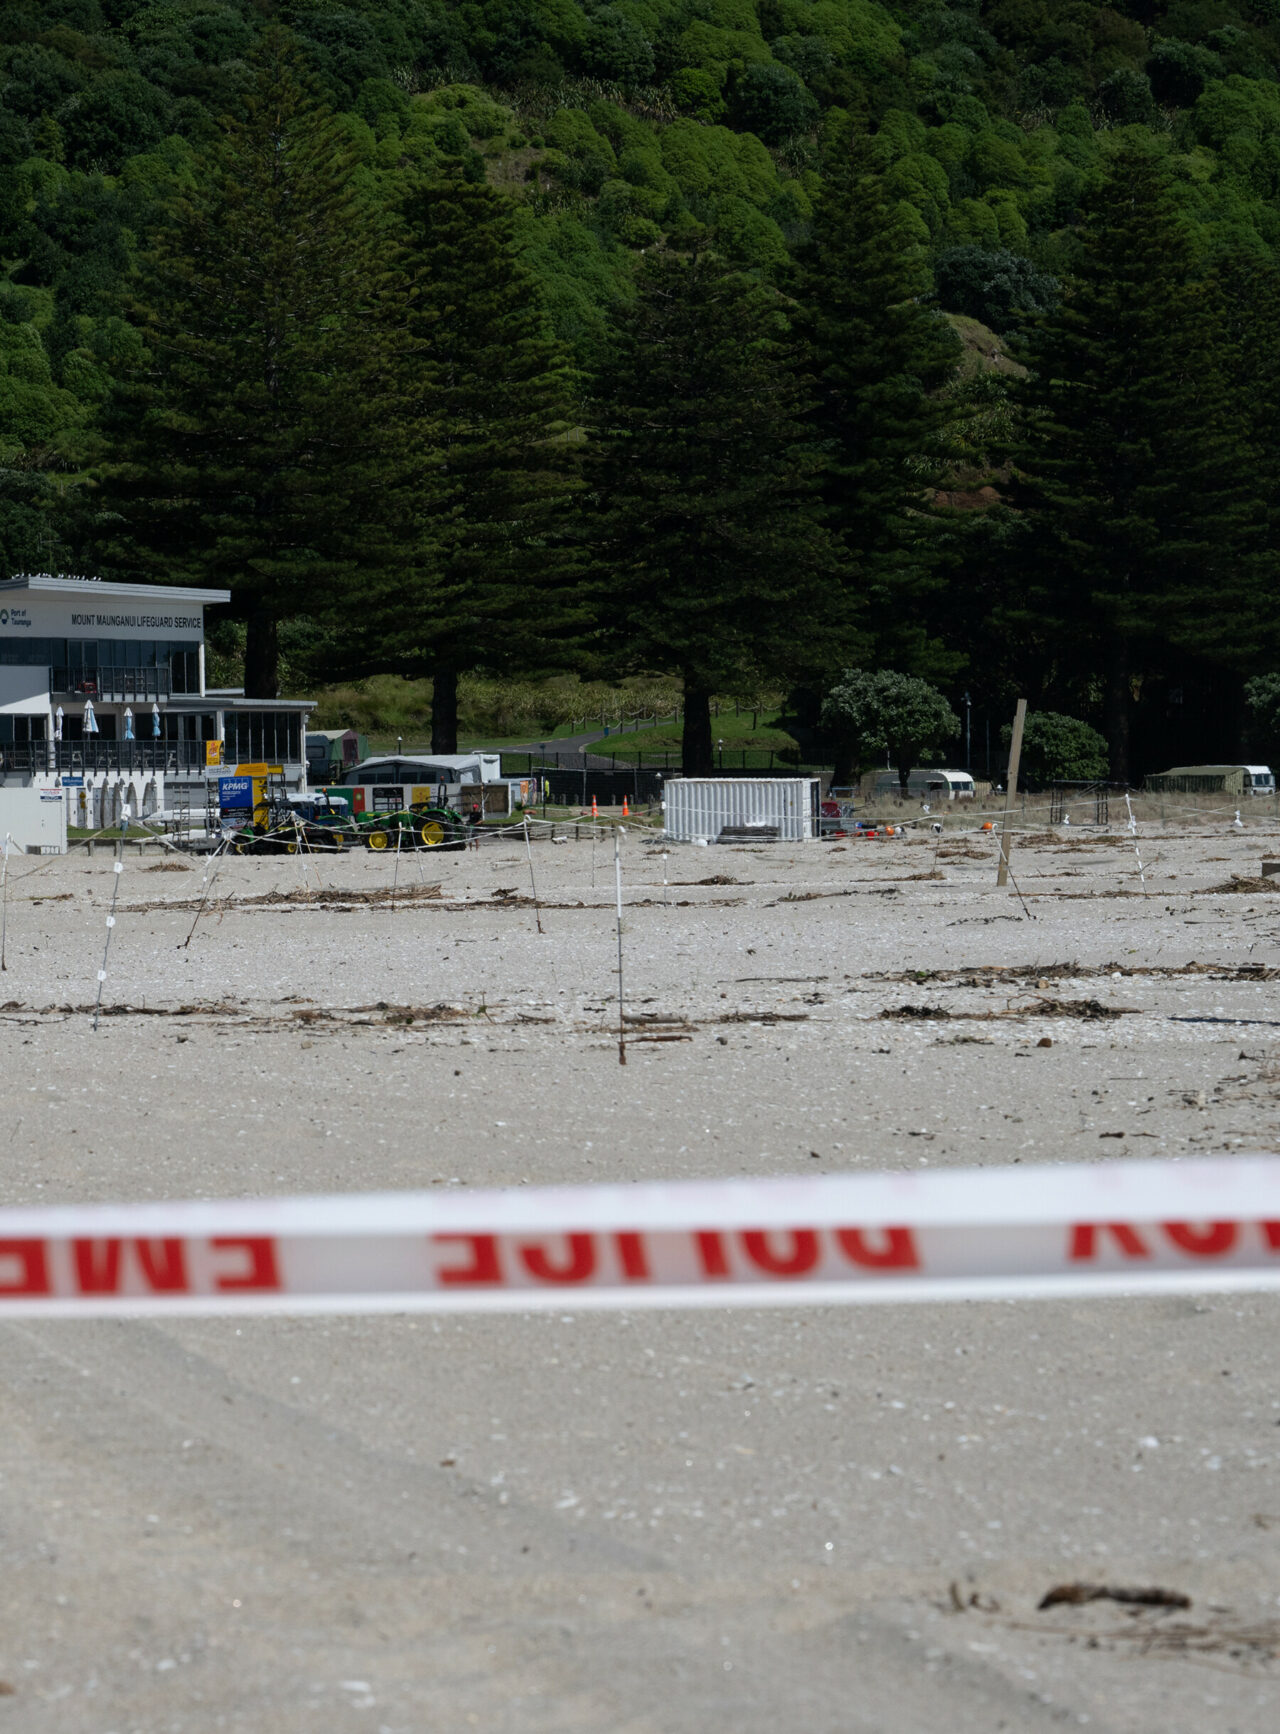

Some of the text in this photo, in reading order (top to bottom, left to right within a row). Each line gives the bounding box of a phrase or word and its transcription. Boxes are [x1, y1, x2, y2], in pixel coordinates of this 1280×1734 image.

[11, 608, 21, 617] Port
[11, 618, 31, 628] Tauranga
[71, 614, 201, 628] MOUNT MAUNGANUI LIFEGUARD SERVICE
[222, 782, 248, 791] KPMG
